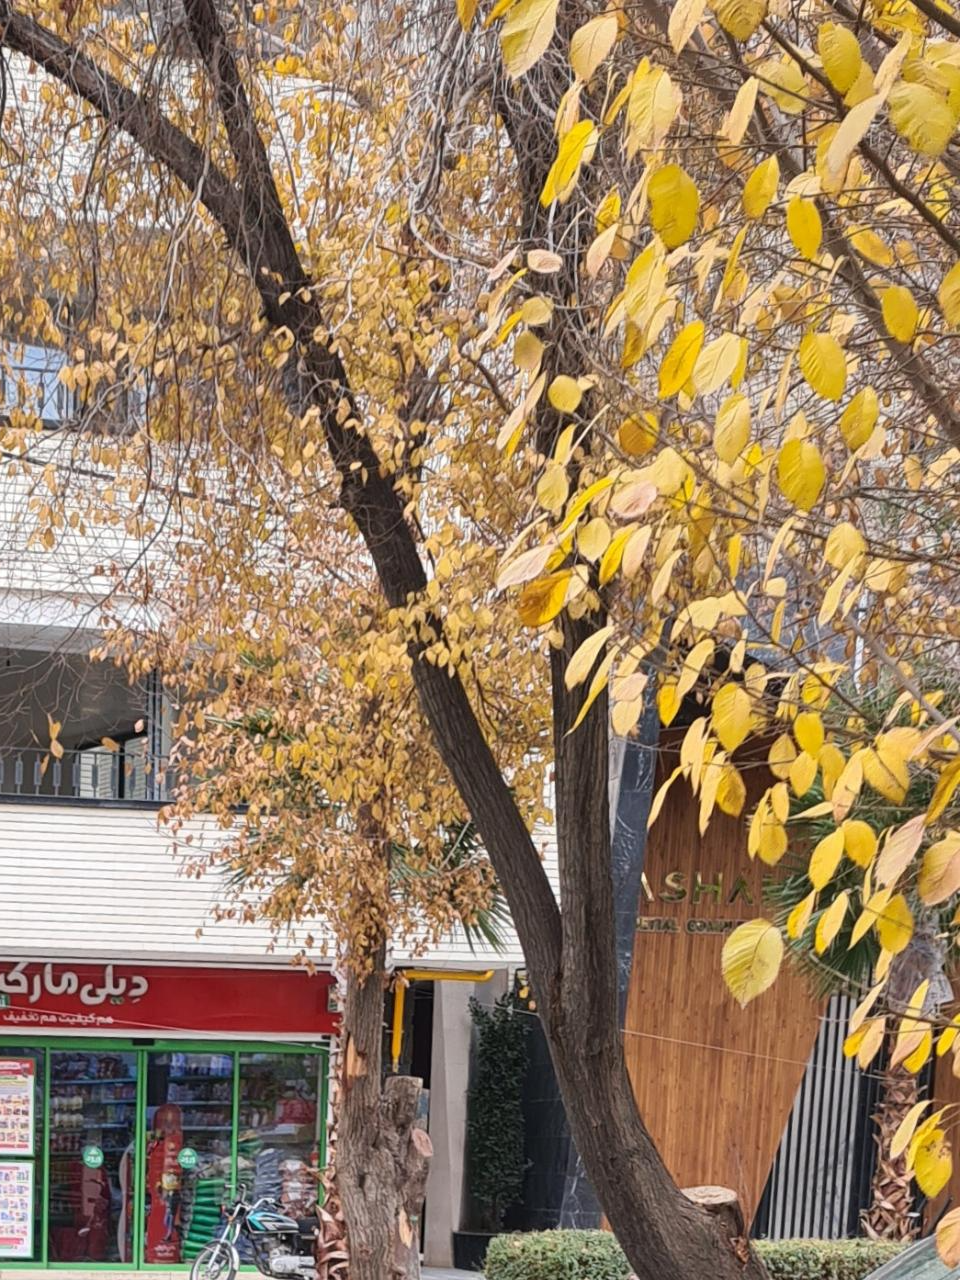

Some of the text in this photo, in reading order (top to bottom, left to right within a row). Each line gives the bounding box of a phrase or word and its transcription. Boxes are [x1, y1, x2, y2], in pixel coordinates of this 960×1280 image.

[2, 1010, 40, 1024] تخفیف
[40, 1014, 58, 1025] هم
[96, 1014, 115, 1026] هم
